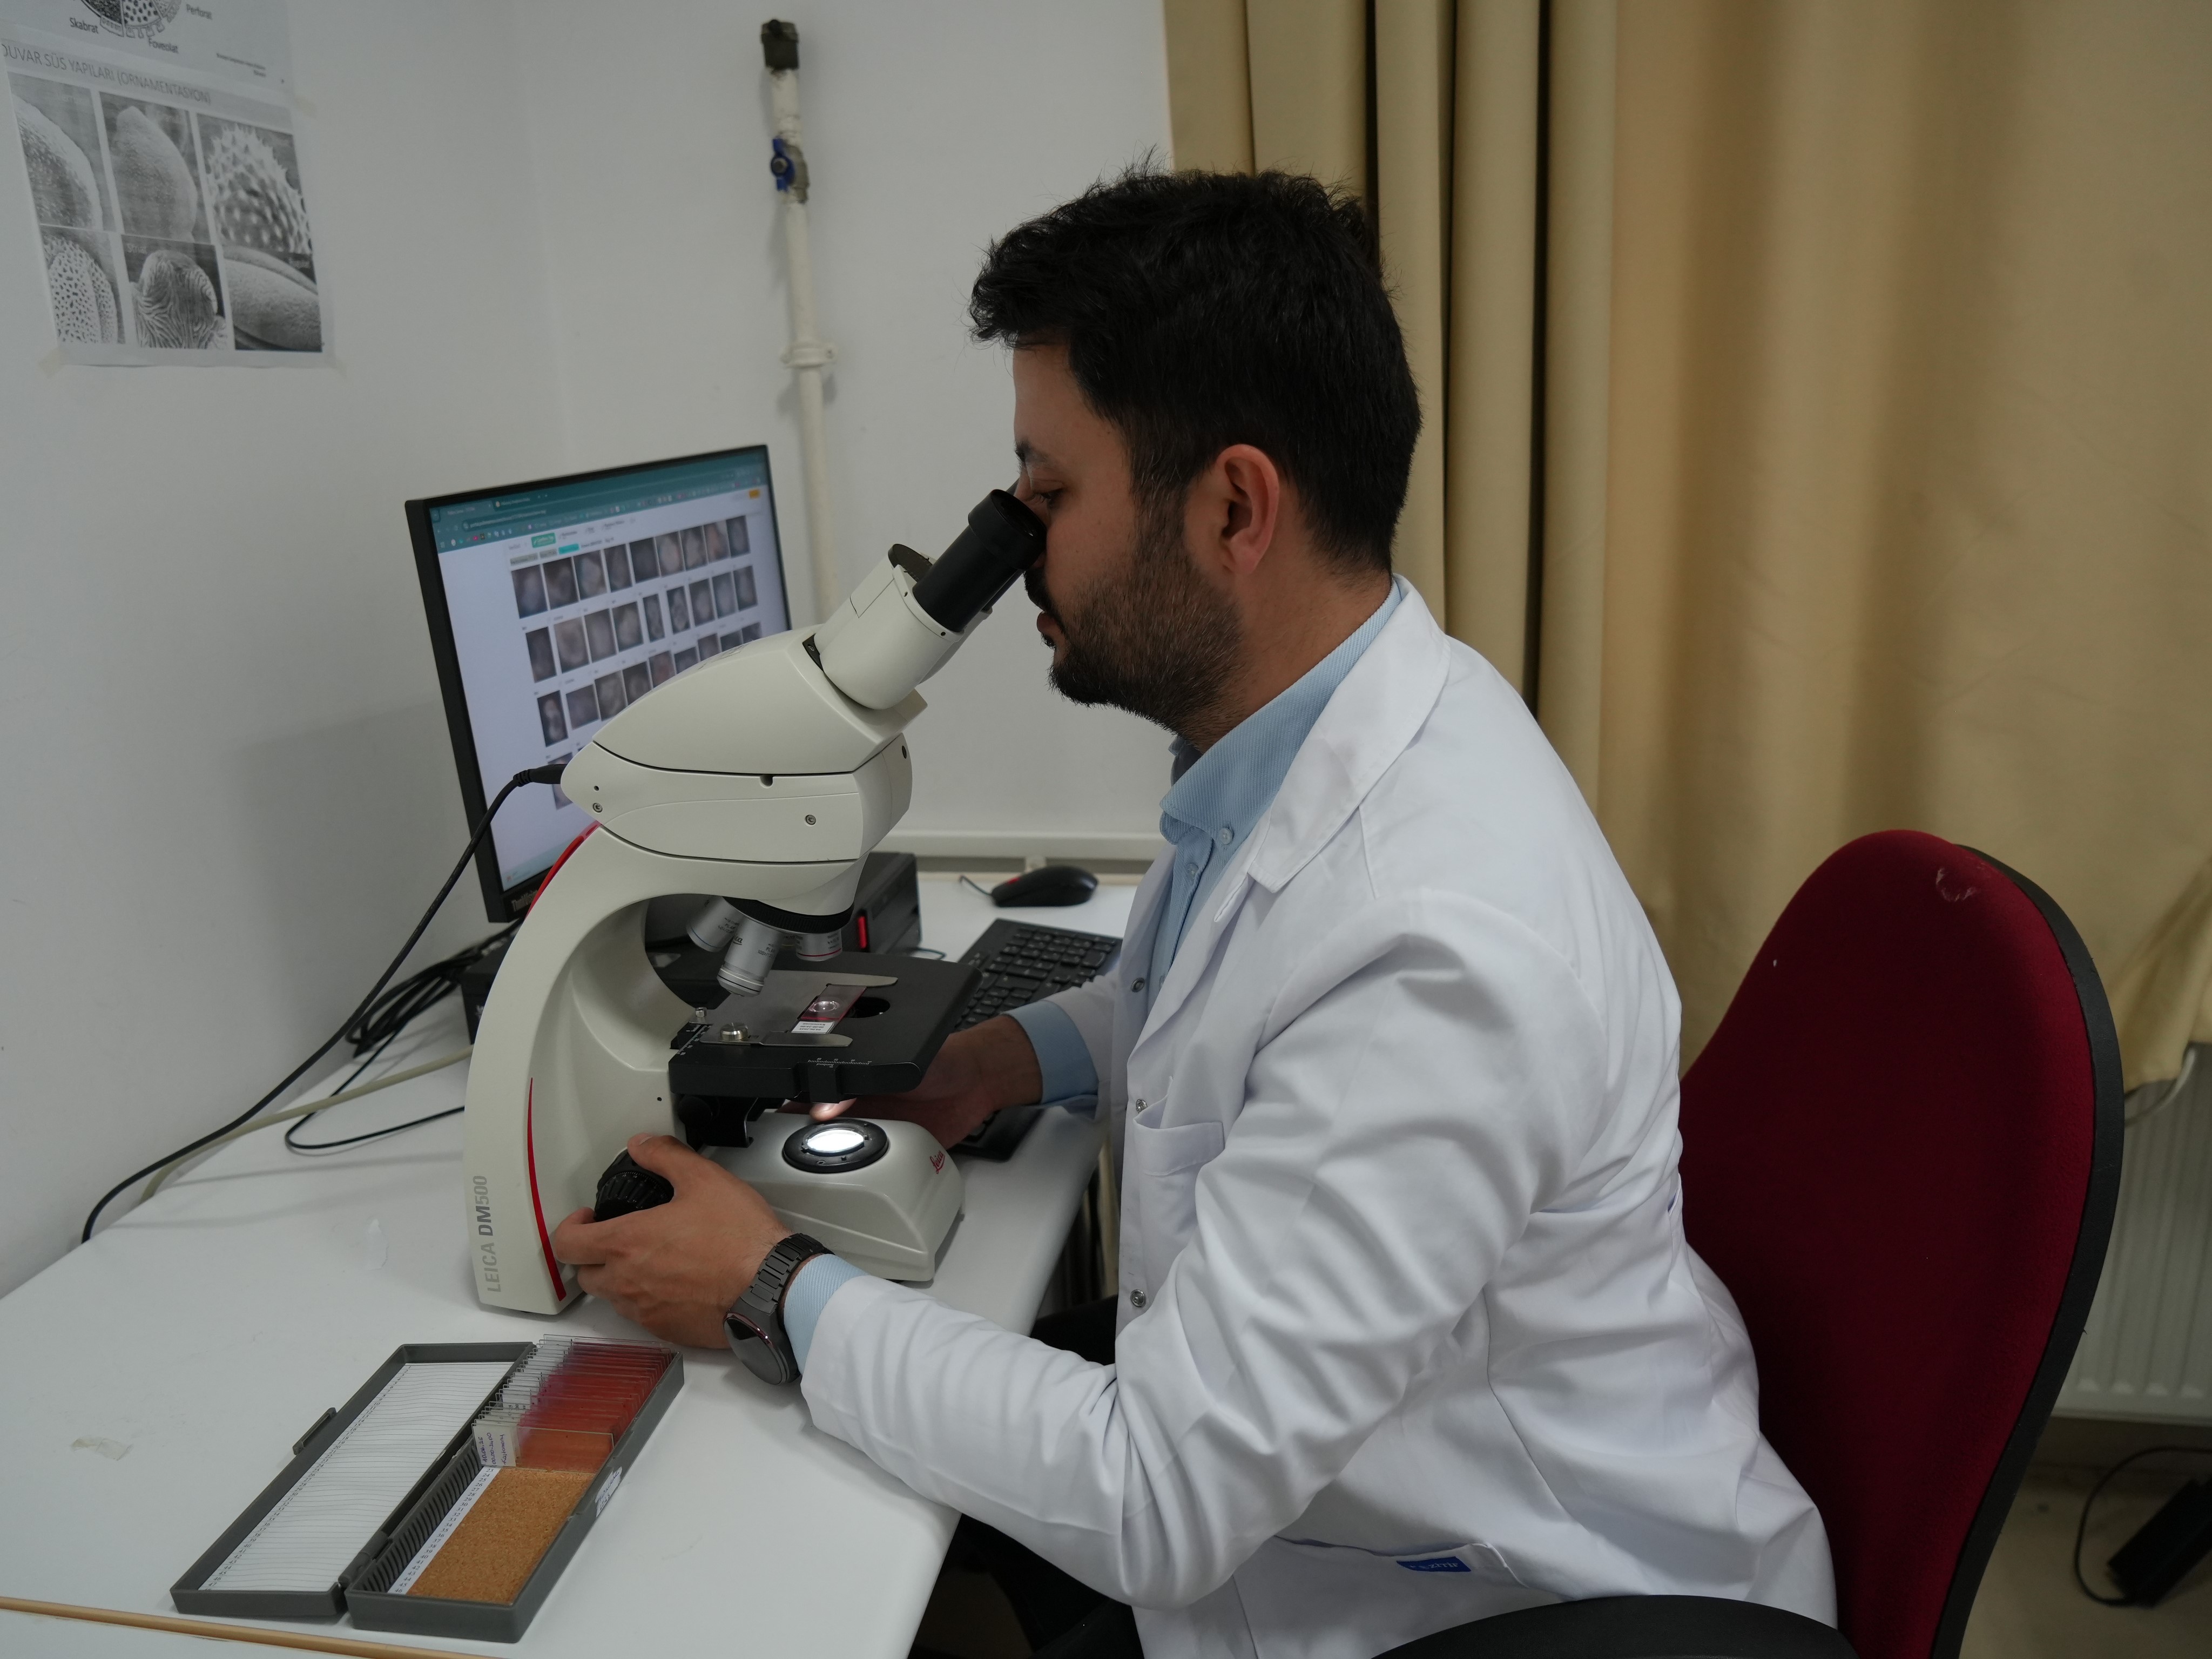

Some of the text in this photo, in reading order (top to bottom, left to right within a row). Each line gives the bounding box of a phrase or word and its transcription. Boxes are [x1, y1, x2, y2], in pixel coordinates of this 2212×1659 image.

[69, 17, 99, 35] Skabrat
[473, 1175, 501, 1292] LEICA DM500
